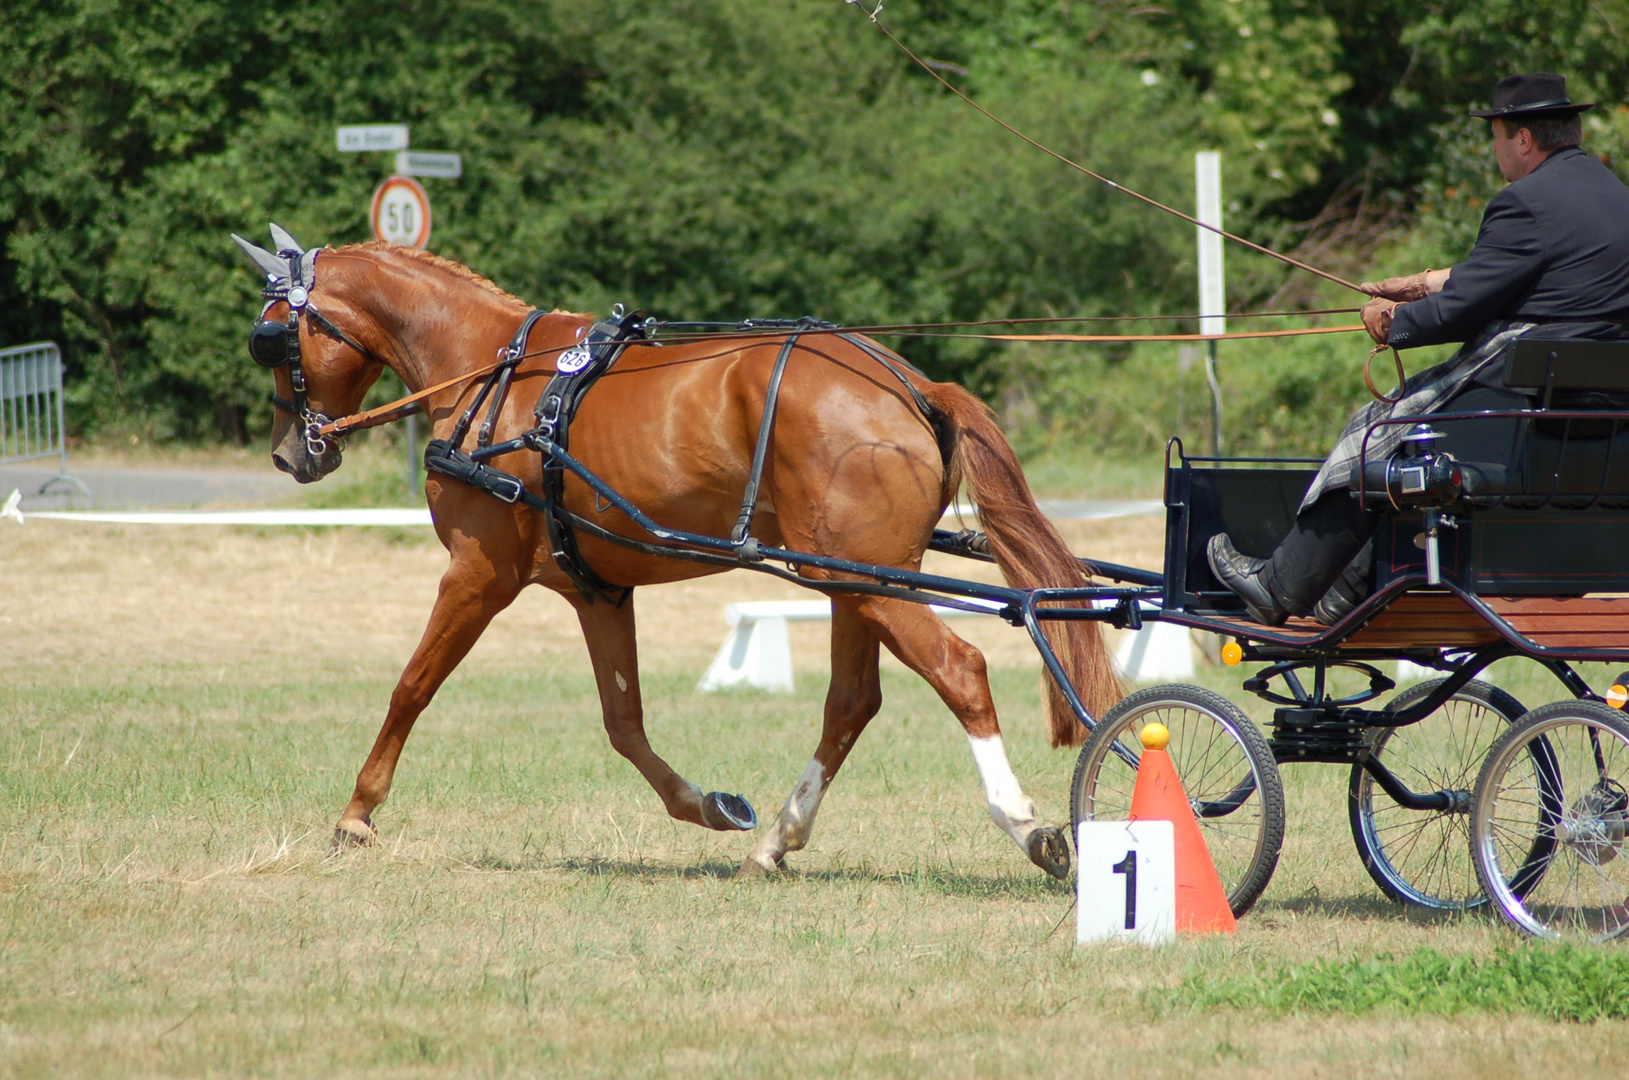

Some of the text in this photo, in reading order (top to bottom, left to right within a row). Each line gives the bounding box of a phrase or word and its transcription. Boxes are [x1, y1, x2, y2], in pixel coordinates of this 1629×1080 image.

[388, 203, 414, 233] 50
[560, 350, 586, 367] 626
[1112, 850, 1137, 929] 1
